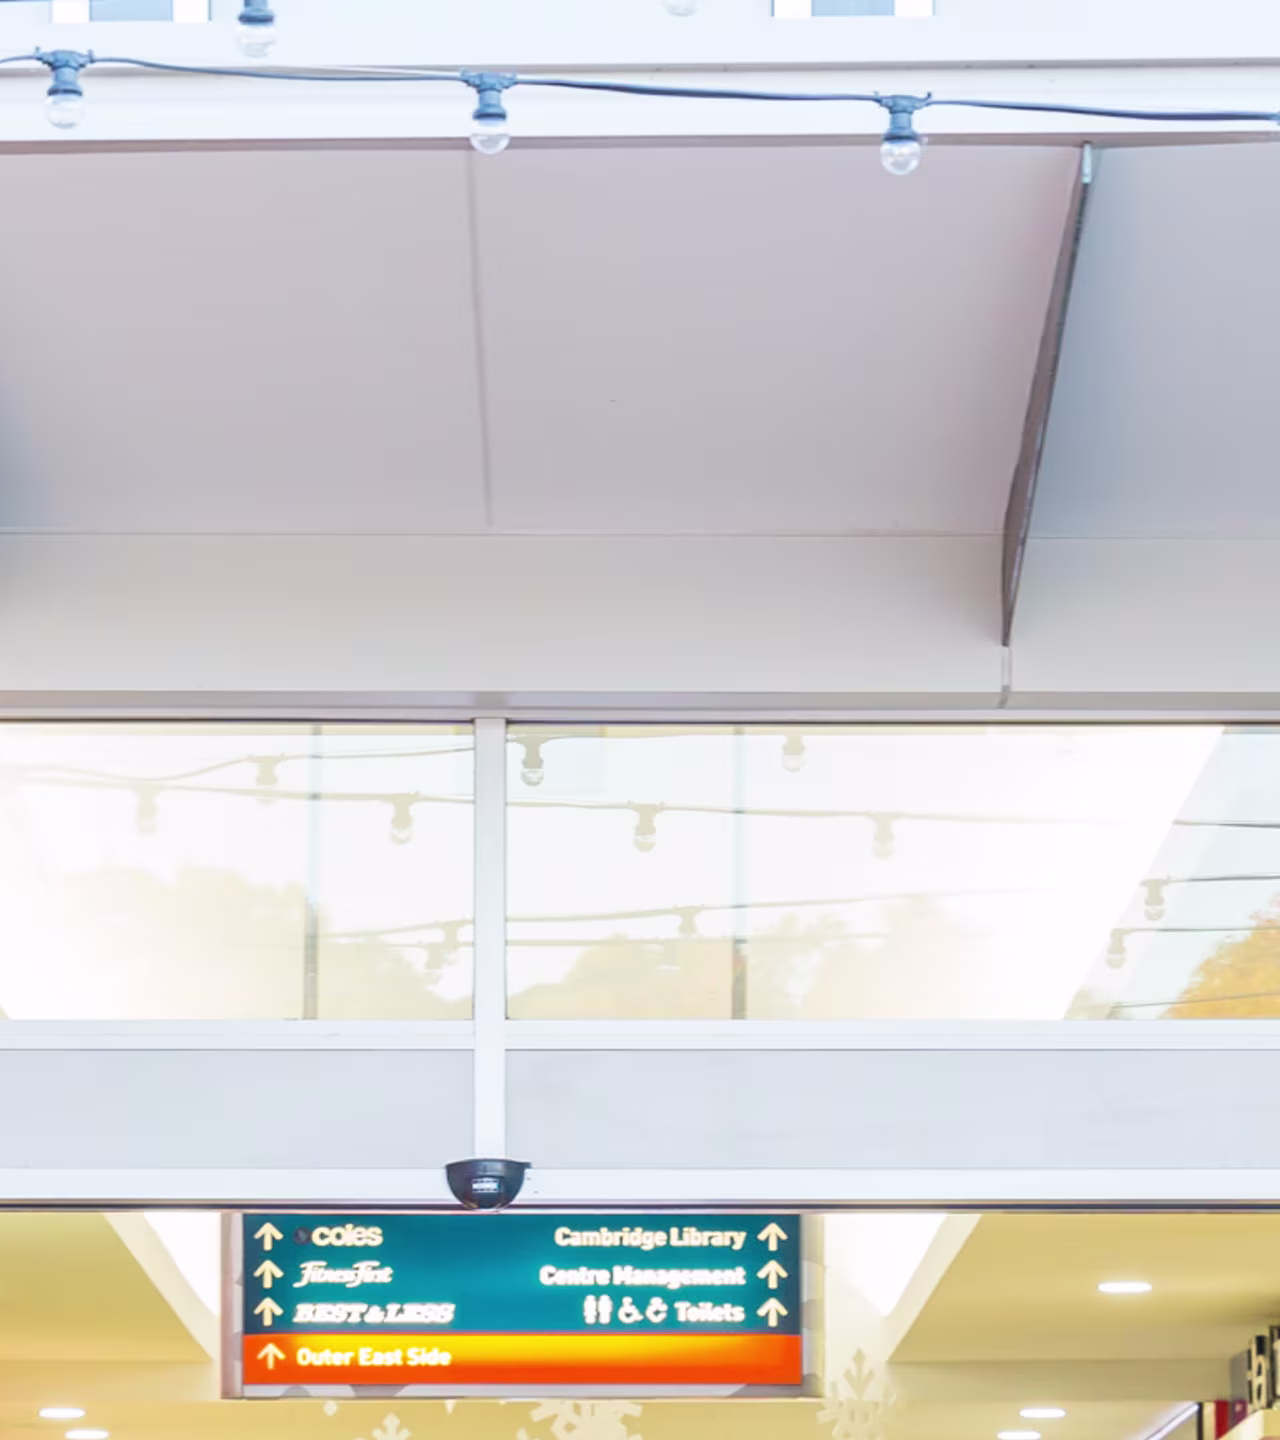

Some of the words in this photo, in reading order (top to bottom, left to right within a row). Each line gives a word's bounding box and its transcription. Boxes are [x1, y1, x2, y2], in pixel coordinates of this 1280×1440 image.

[312, 1224, 383, 1247] coles
[554, 1226, 667, 1250] Cambridge
[669, 1226, 746, 1250] Library
[539, 1265, 611, 1286] Centre
[612, 1265, 746, 1290] Management
[675, 1301, 745, 1323] Toilets
[296, 1347, 354, 1366] Outer
[358, 1347, 402, 1366] East
[406, 1347, 452, 1366] Side
